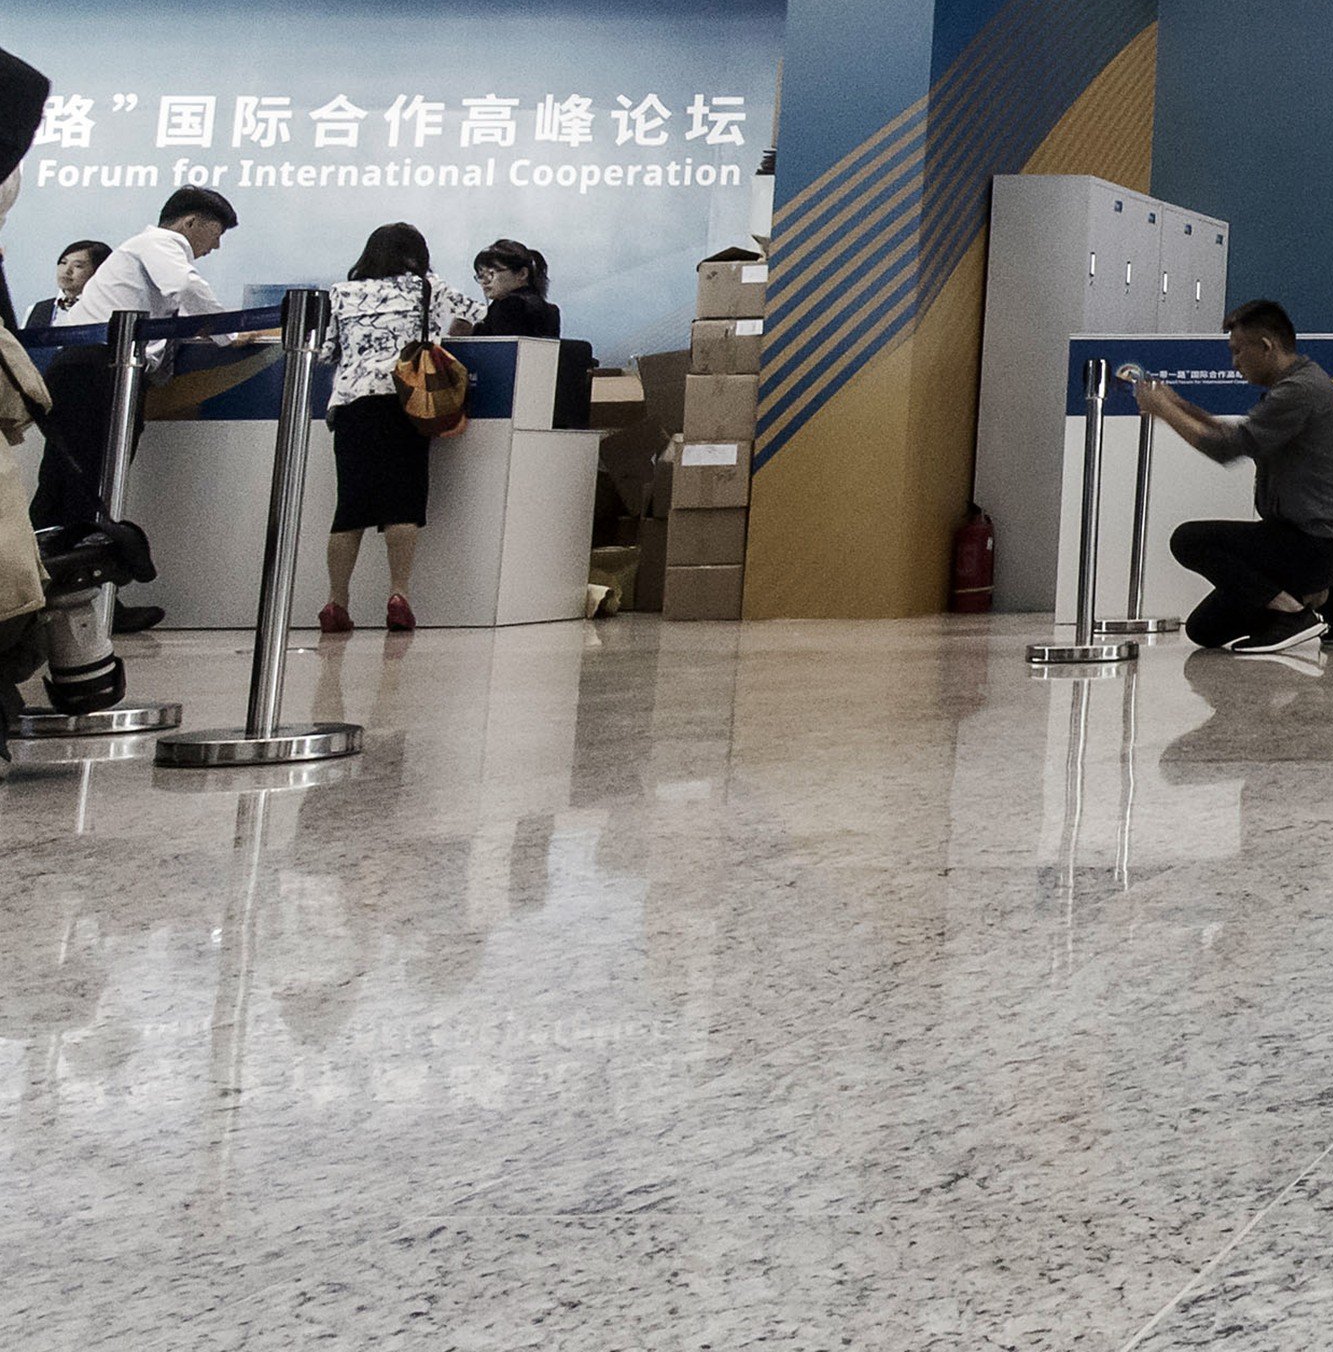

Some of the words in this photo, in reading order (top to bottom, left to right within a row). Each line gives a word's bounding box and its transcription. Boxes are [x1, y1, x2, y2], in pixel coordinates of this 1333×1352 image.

[37, 160, 158, 188] Forum
[172, 158, 229, 188] for
[239, 158, 495, 188] International
[509, 158, 741, 194] Cooperation
